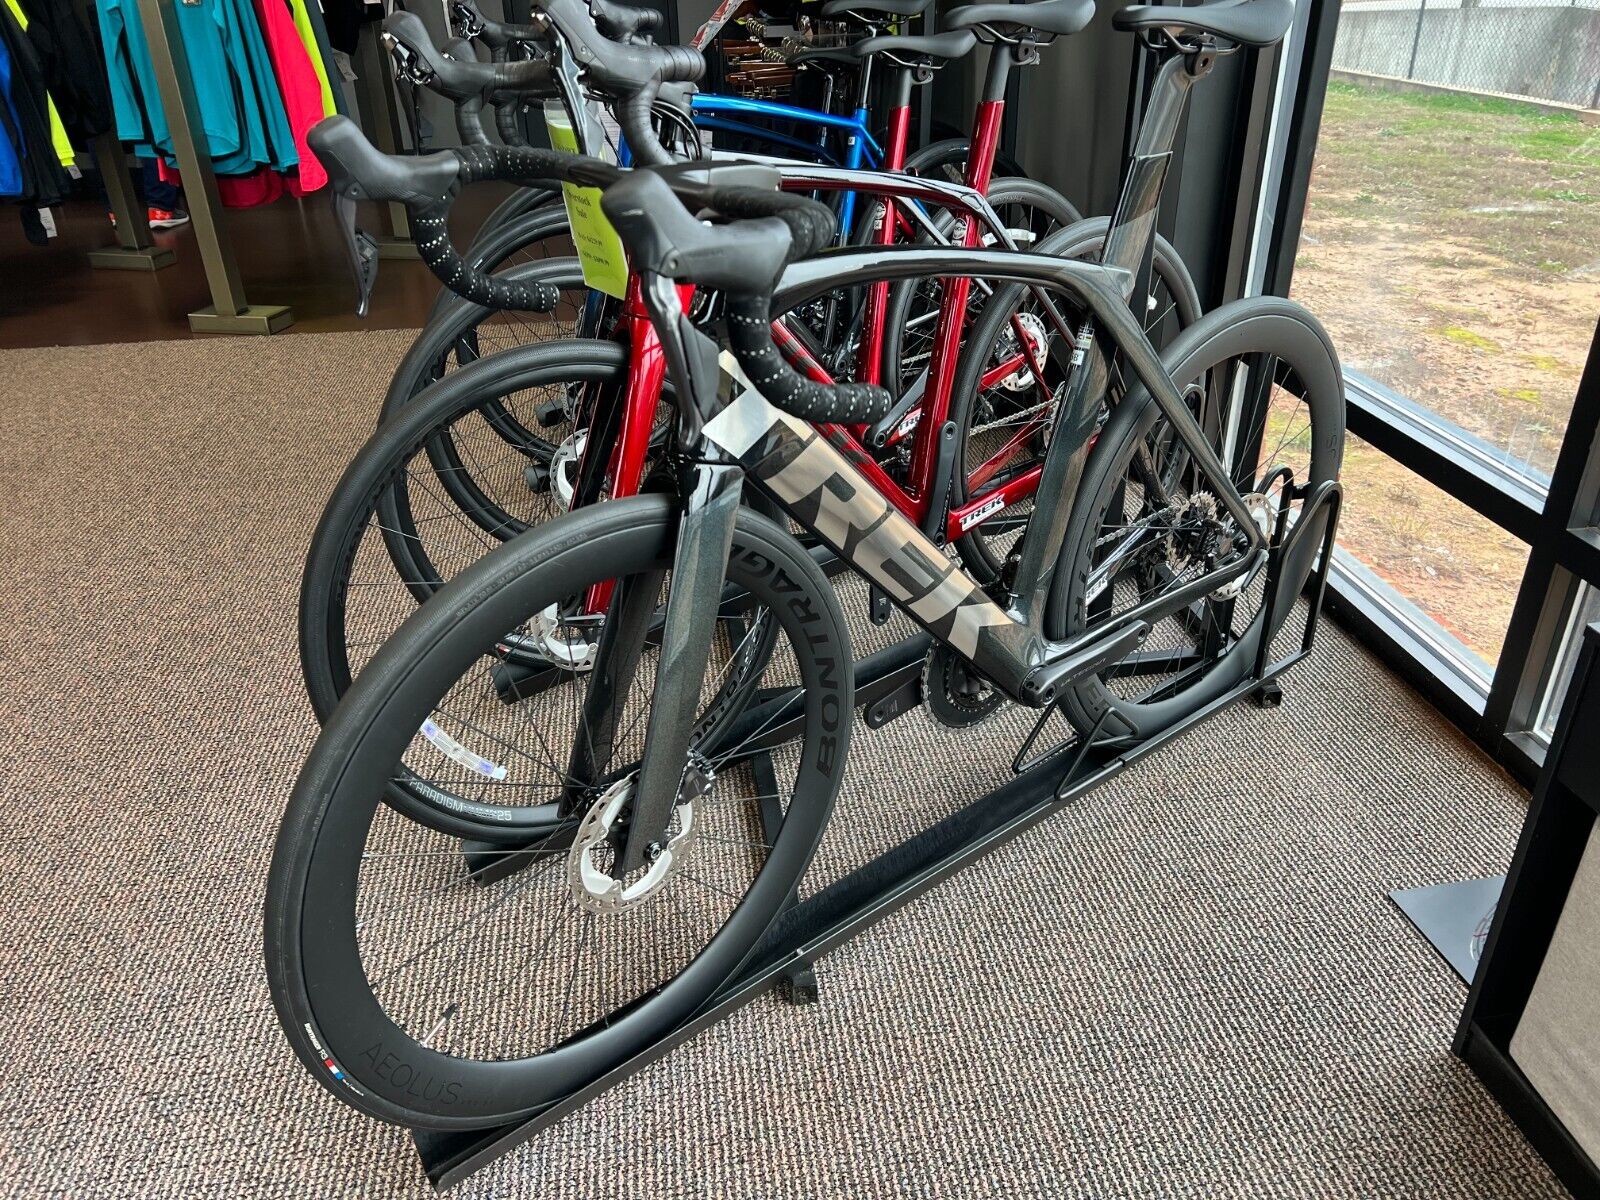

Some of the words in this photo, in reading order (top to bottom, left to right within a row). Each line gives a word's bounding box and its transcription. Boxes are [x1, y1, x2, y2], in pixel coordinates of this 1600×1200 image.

[702, 348, 1014, 661] TREK
[959, 494, 1005, 528] TREK
[730, 543, 839, 779] BONTRAG
[409, 777, 463, 812] PARADIGM
[497, 810, 512, 821] 25
[358, 1042, 463, 1103] AEOLUS
